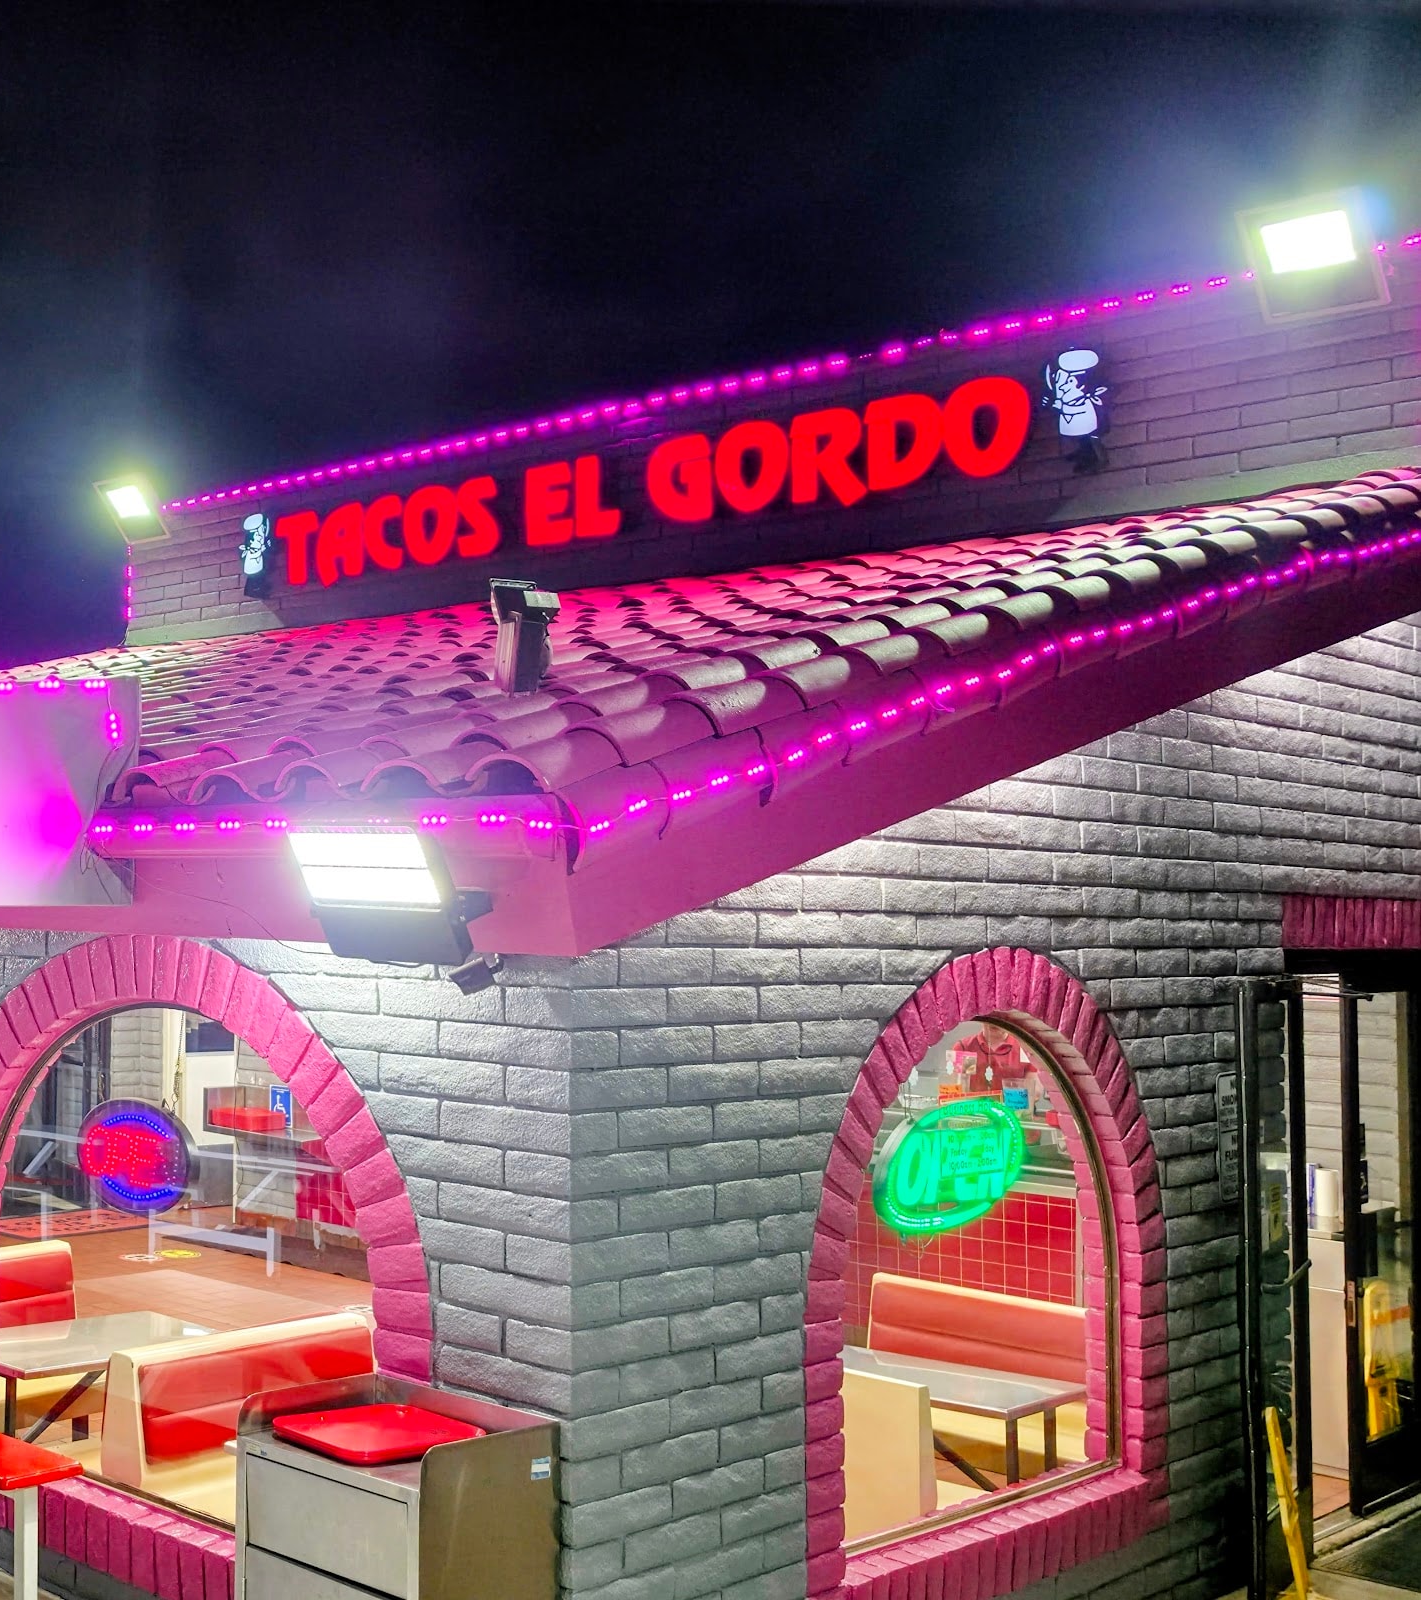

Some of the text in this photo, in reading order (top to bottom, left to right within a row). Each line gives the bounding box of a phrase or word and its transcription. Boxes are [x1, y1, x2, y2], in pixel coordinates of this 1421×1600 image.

[274, 375, 1030, 588] TACOS EL GORDO
[85, 1125, 181, 1189] OPEN
[896, 1128, 1013, 1206] OPEN
